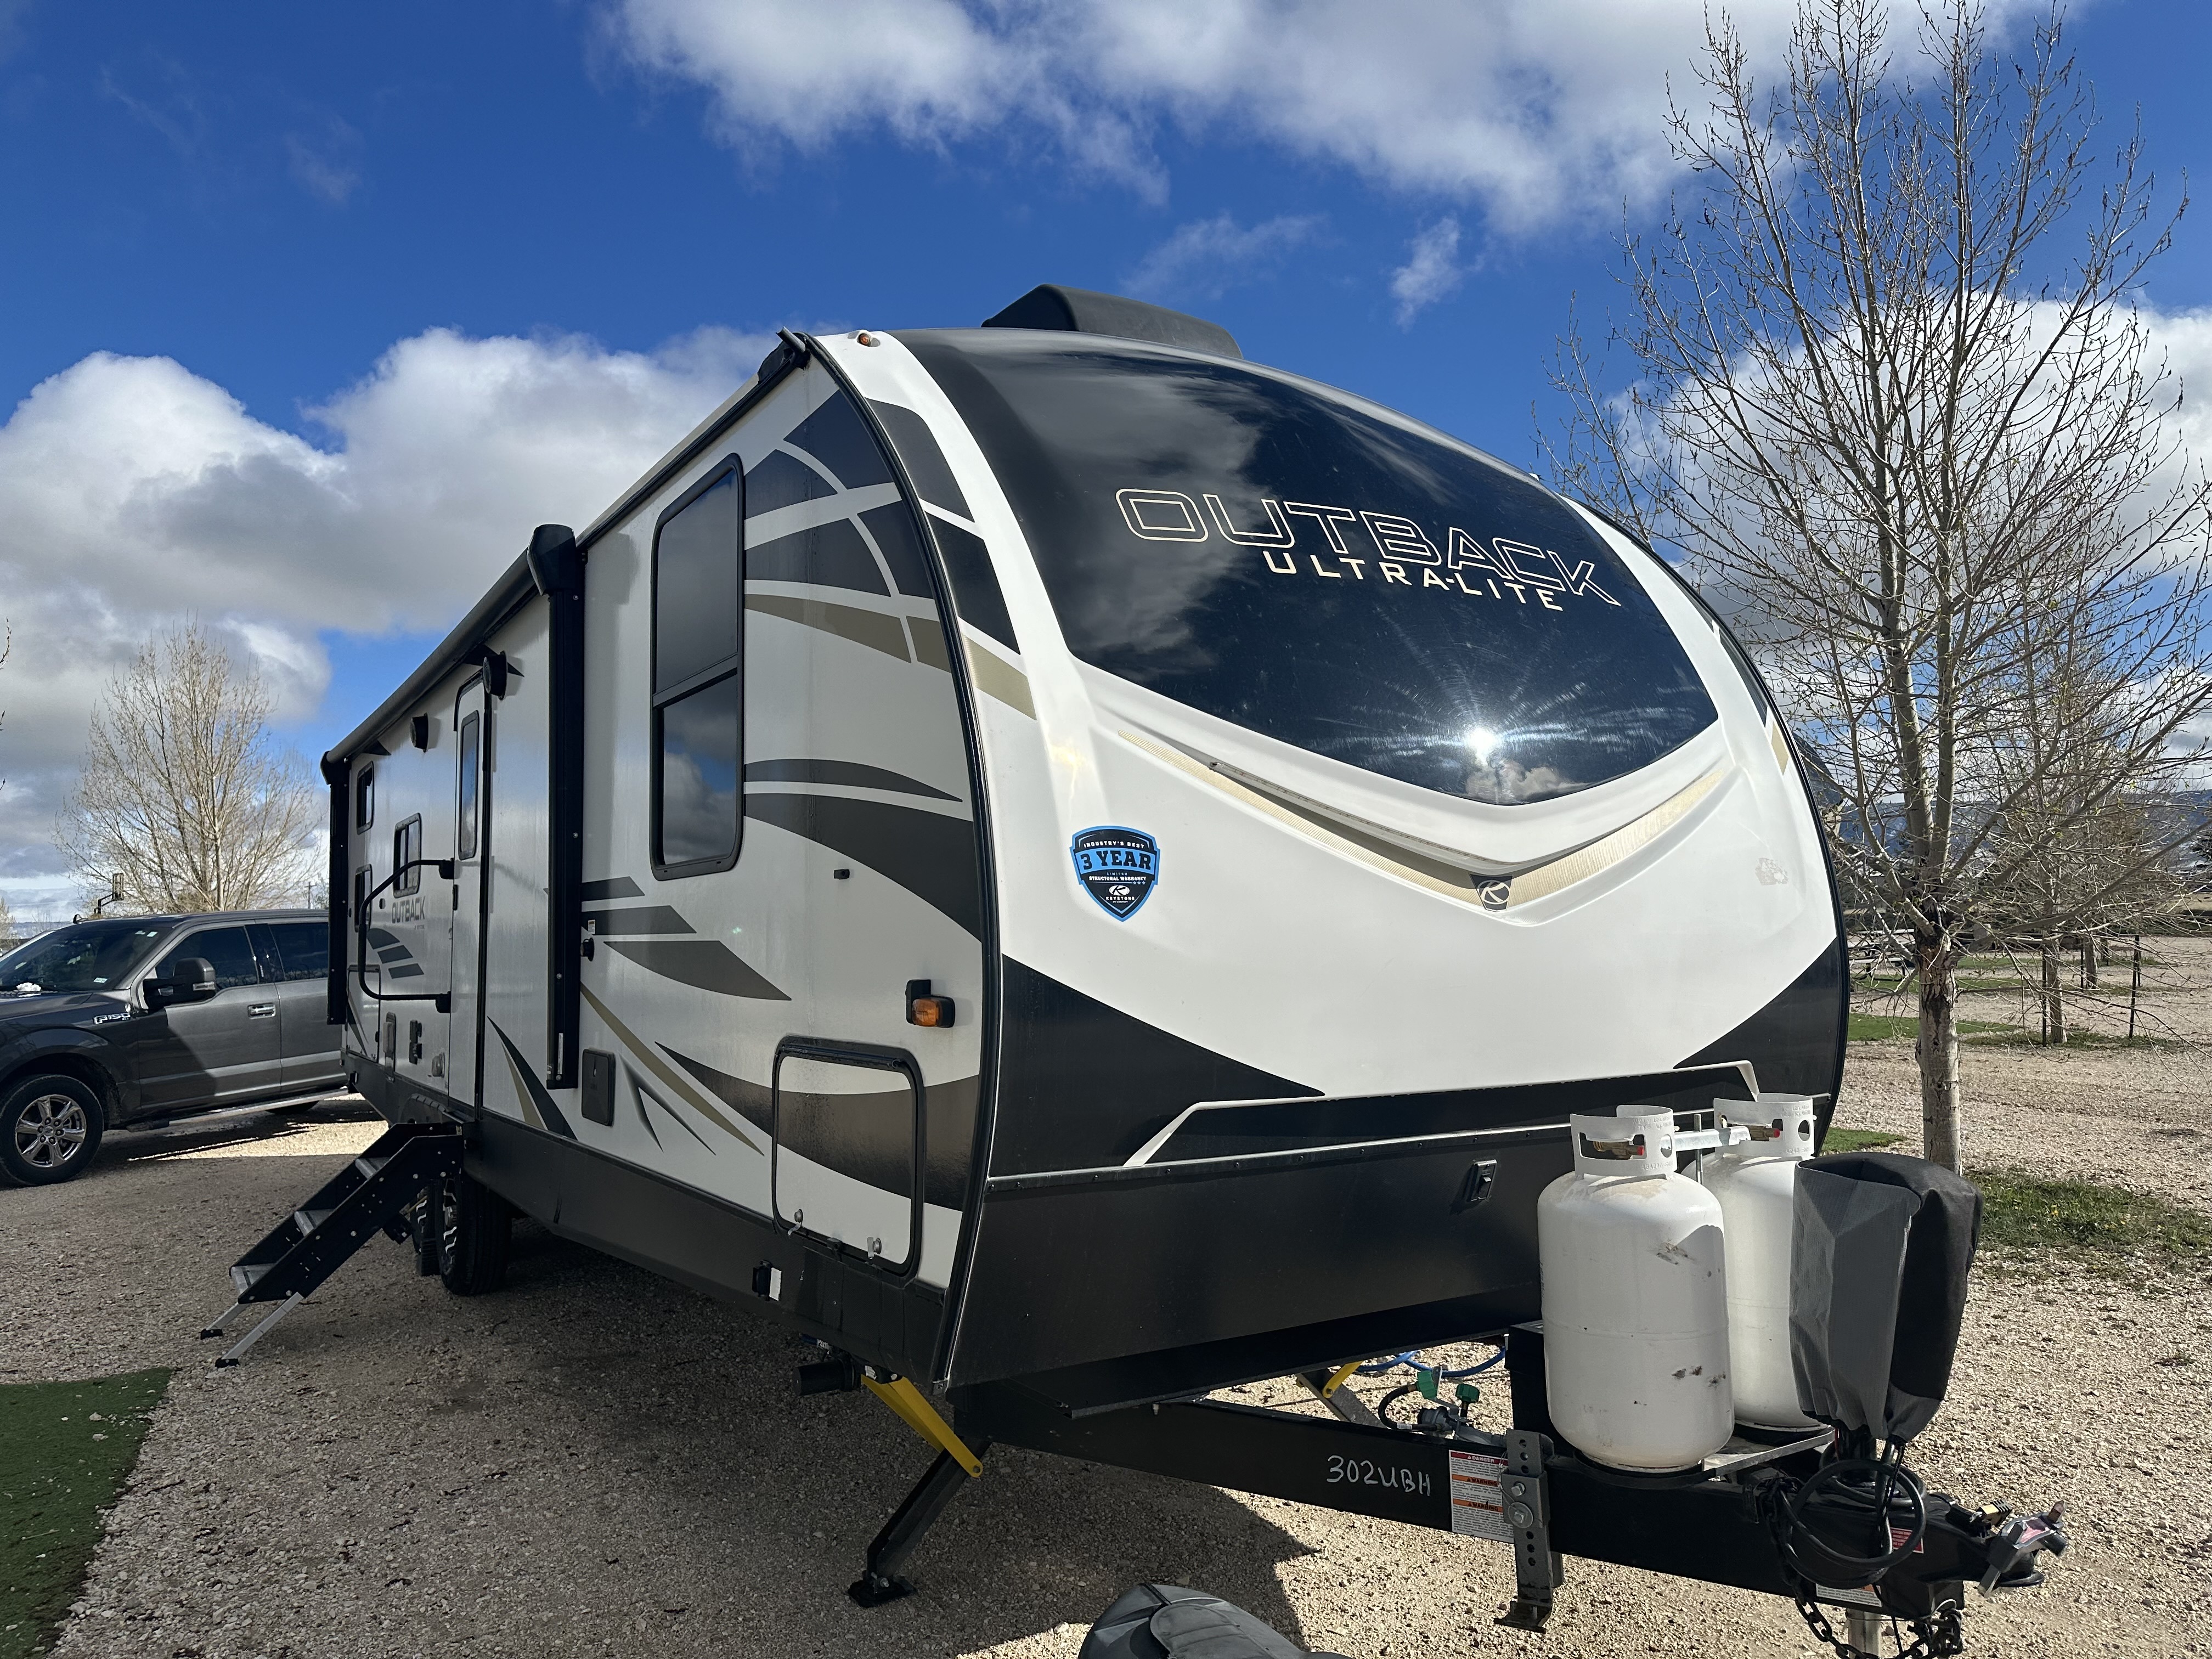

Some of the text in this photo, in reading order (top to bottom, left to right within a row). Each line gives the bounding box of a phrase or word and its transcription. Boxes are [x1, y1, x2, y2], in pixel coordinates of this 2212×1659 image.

[1115, 488, 1622, 607] OUTBACK
[1263, 550, 1564, 611] ULTRA-LITE
[1080, 850, 1152, 871] 3 YEAR
[392, 895, 426, 924] OUTBACK
[1327, 1455, 1430, 1497] 302UBH
[1471, 1478, 1497, 1486] WARNING
[1472, 1502, 1498, 1511] WARNING
